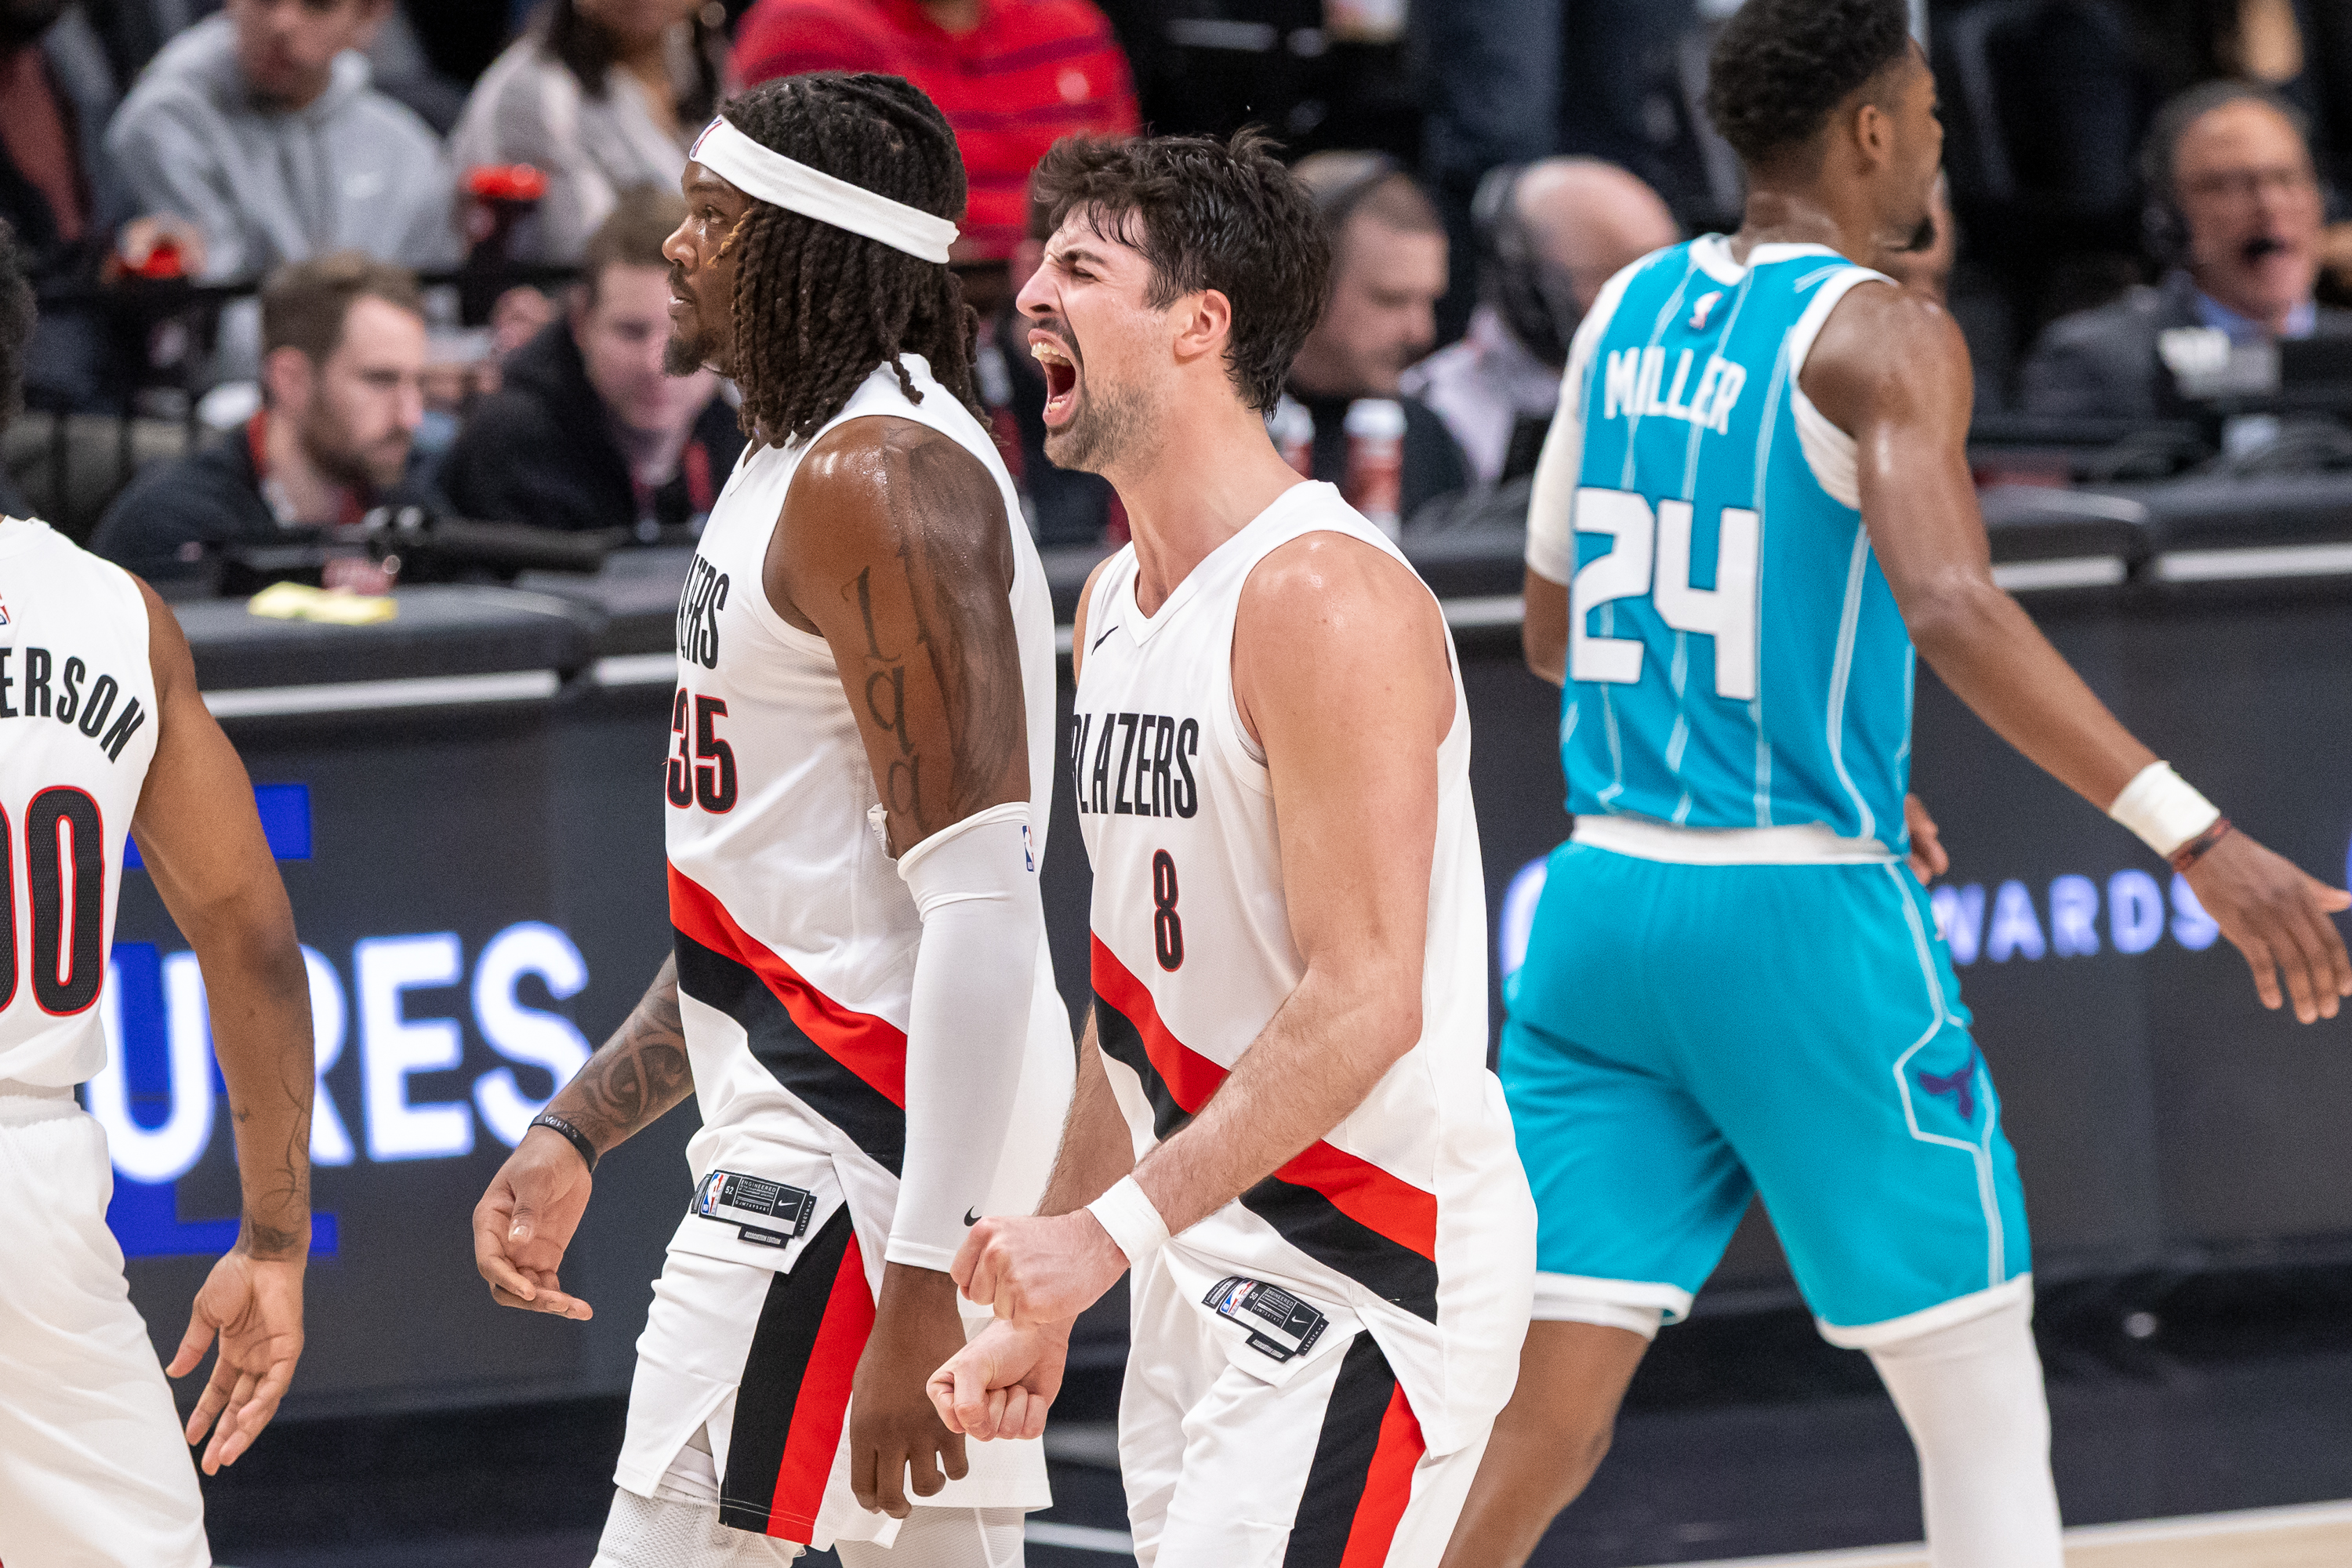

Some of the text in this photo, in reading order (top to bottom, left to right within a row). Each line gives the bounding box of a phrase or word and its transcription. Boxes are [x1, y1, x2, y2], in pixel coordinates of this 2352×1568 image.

[1603, 346, 1747, 434] MILLER
[1570, 486, 1760, 700] 24
[667, 688, 738, 814] 35
[0, 785, 104, 1017] 0
[1152, 848, 1184, 972] 8
[724, 1185, 735, 1195] 52
[741, 1179, 776, 1192] ENGINEERED
[1249, 1291, 1258, 1301] 50
